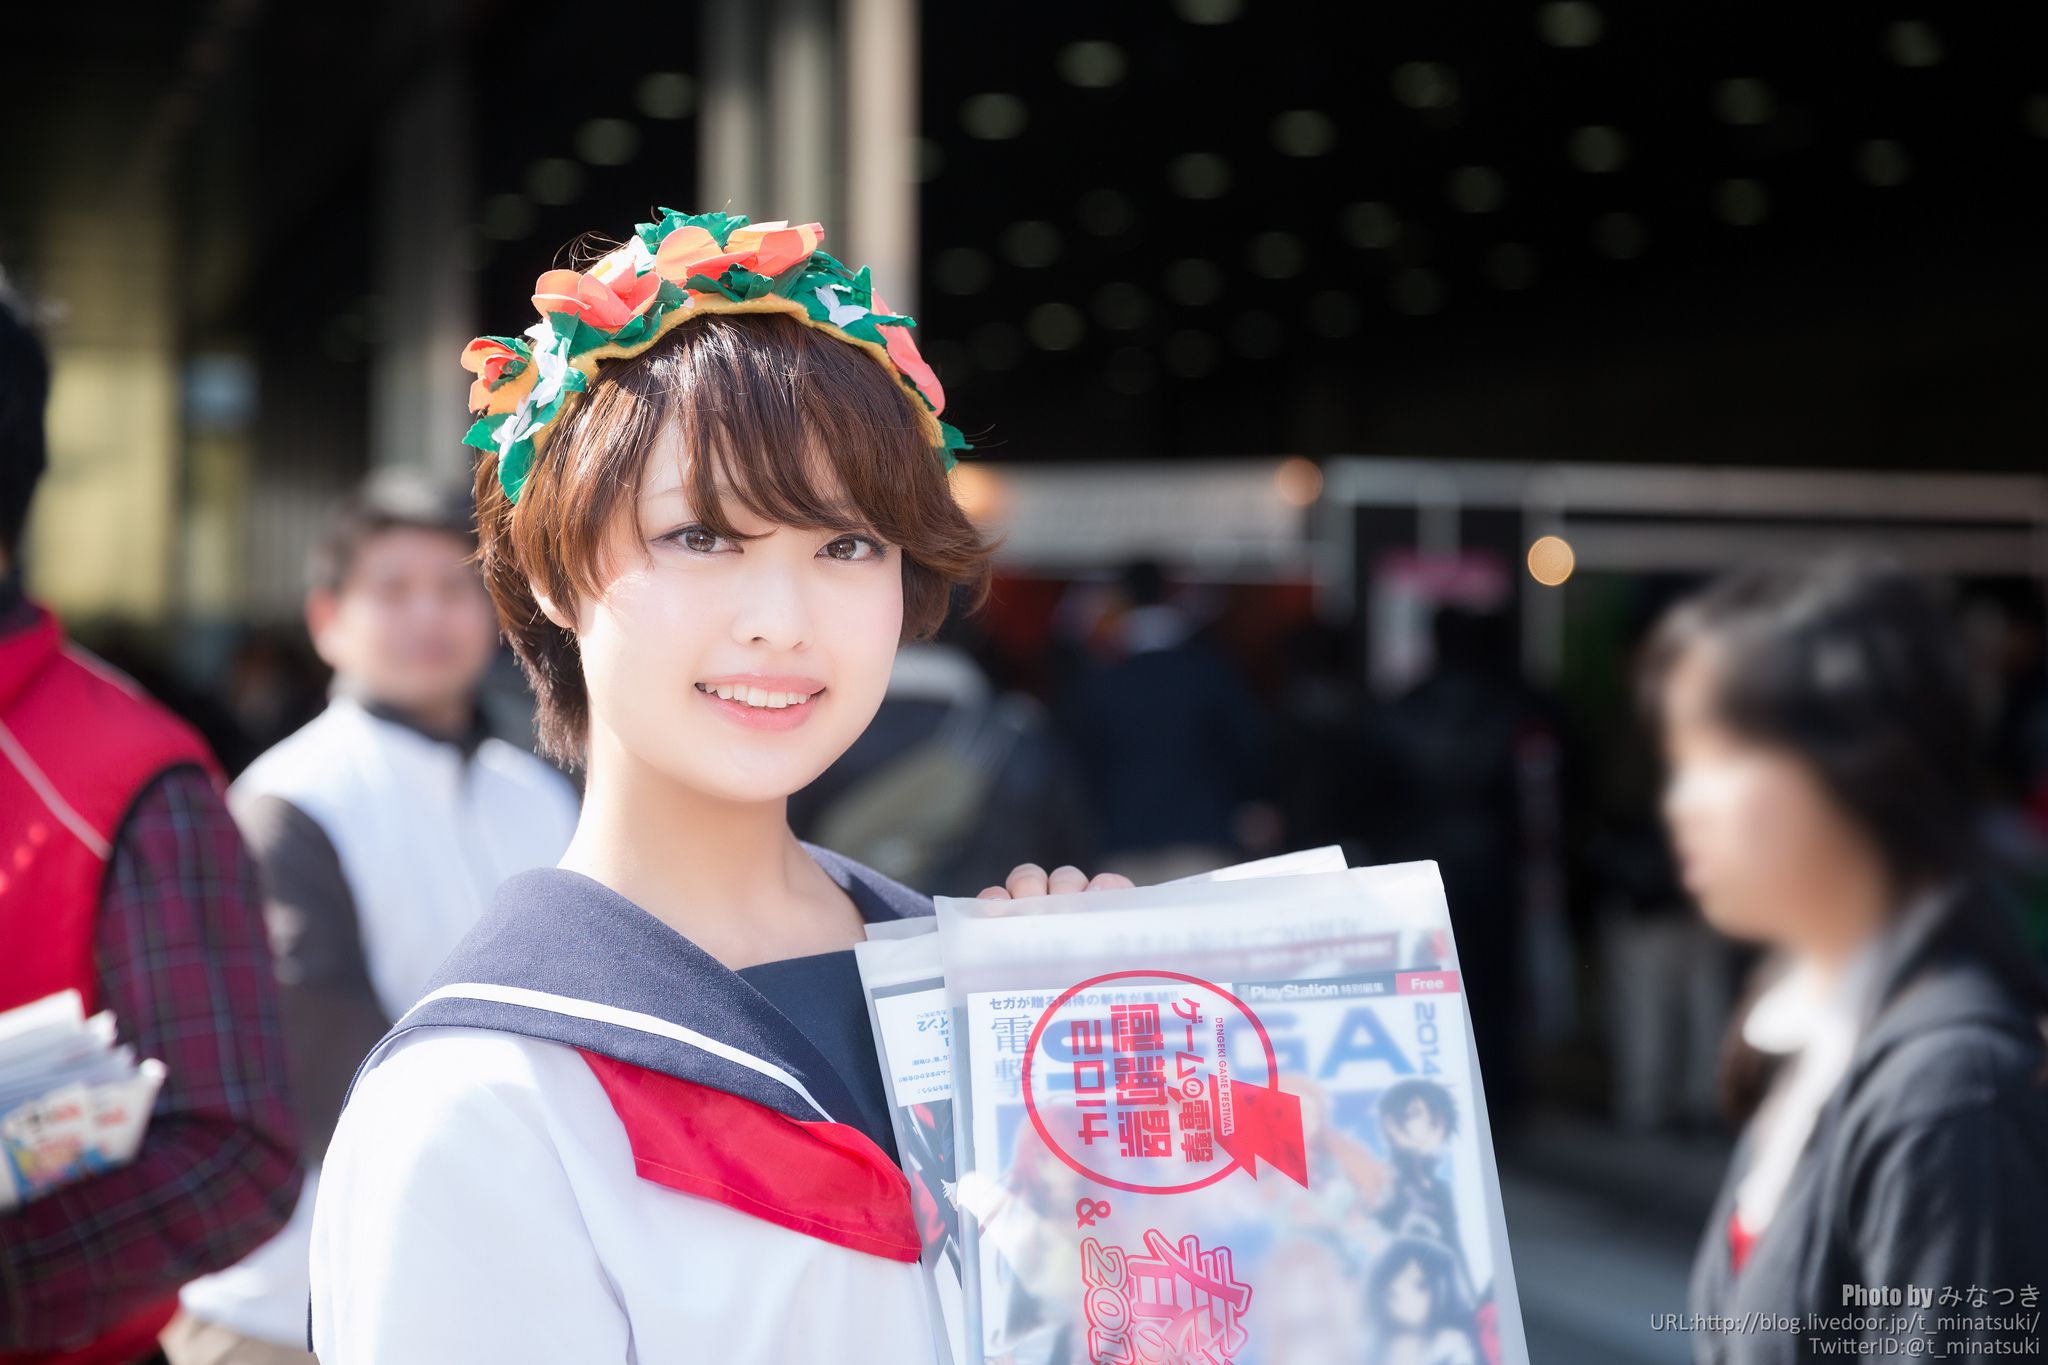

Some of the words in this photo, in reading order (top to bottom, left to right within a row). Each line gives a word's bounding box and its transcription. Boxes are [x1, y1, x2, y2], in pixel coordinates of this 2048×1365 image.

[1250, 982, 1339, 1001] PlayStation
[1410, 978, 1444, 991] Free
[1215, 1017, 1227, 1059] DENGEKI
[1414, 1002, 1442, 1077] 2014
[1070, 1020, 1109, 1145] 2014
[1110, 1003, 1173, 1159] 感謝祭
[1171, 997, 1214, 1163] ゲームの電撃
[1218, 1060, 1229, 1089] GAME
[1220, 1088, 1233, 1135] FESTIVAL
[1075, 1197, 1111, 1229] &
[1080, 1236, 1133, 1365] 201
